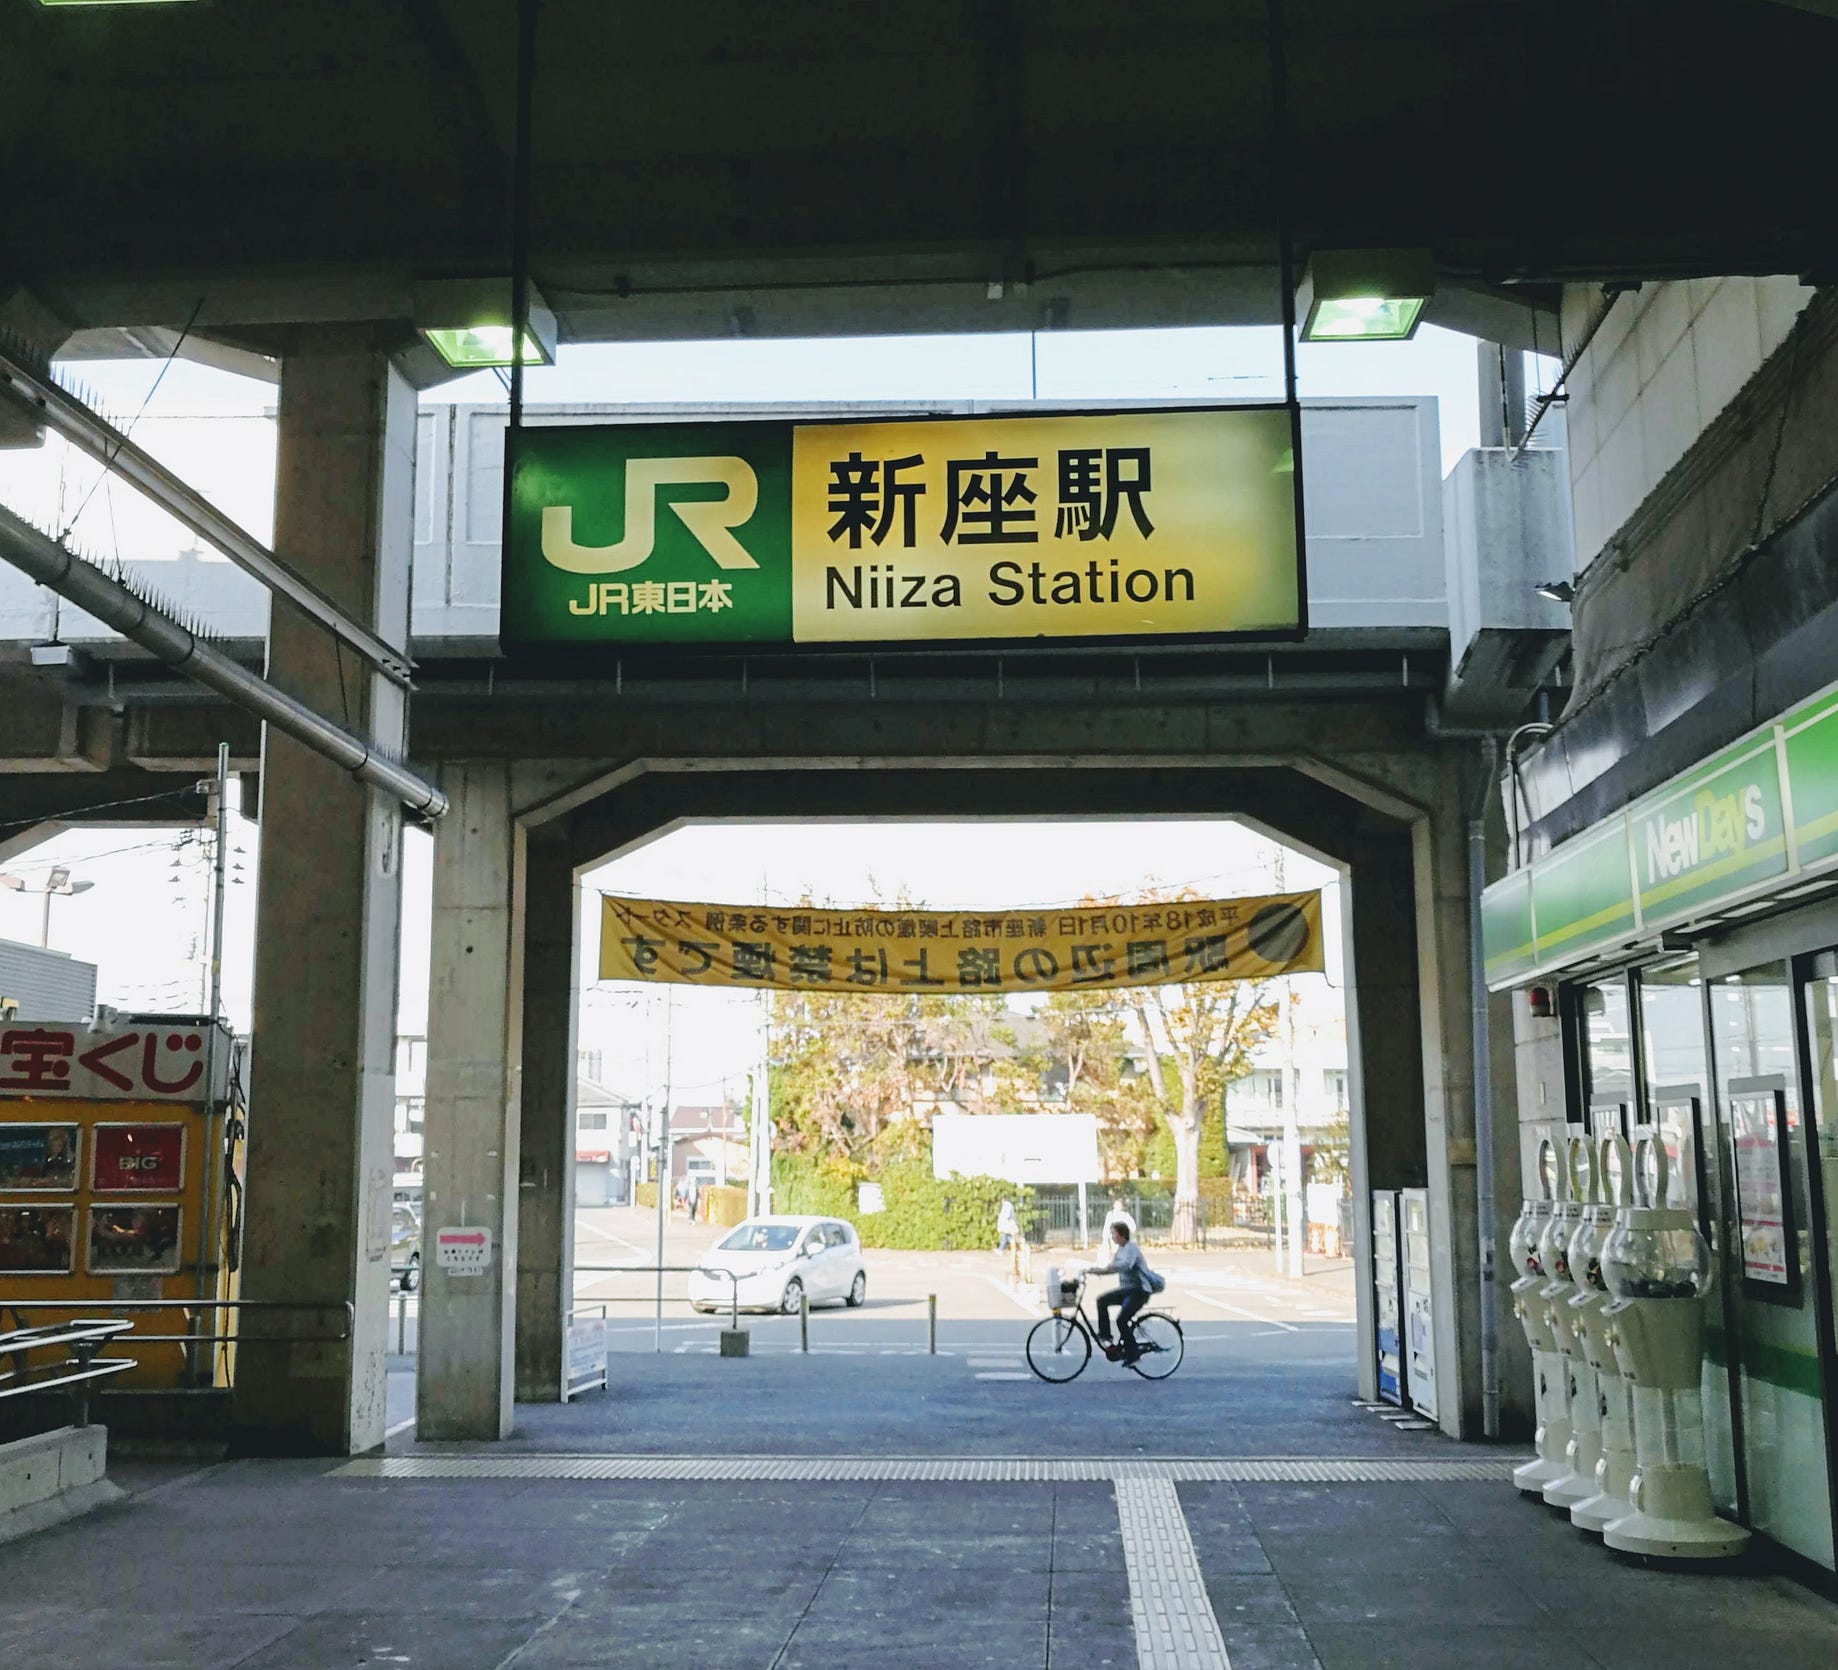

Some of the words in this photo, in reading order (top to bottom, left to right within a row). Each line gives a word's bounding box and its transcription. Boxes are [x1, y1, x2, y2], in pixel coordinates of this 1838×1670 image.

[541, 456, 760, 574] JR
[827, 447, 1155, 549] 新座駅
[569, 578, 733, 618] JR東日本
[827, 563, 962, 611] Niiza
[988, 558, 1195, 607] Station
[1645, 783, 1766, 885] NewDays
[0, 1028, 204, 1094] 宝くじ
[118, 1155, 158, 1171] BIG
